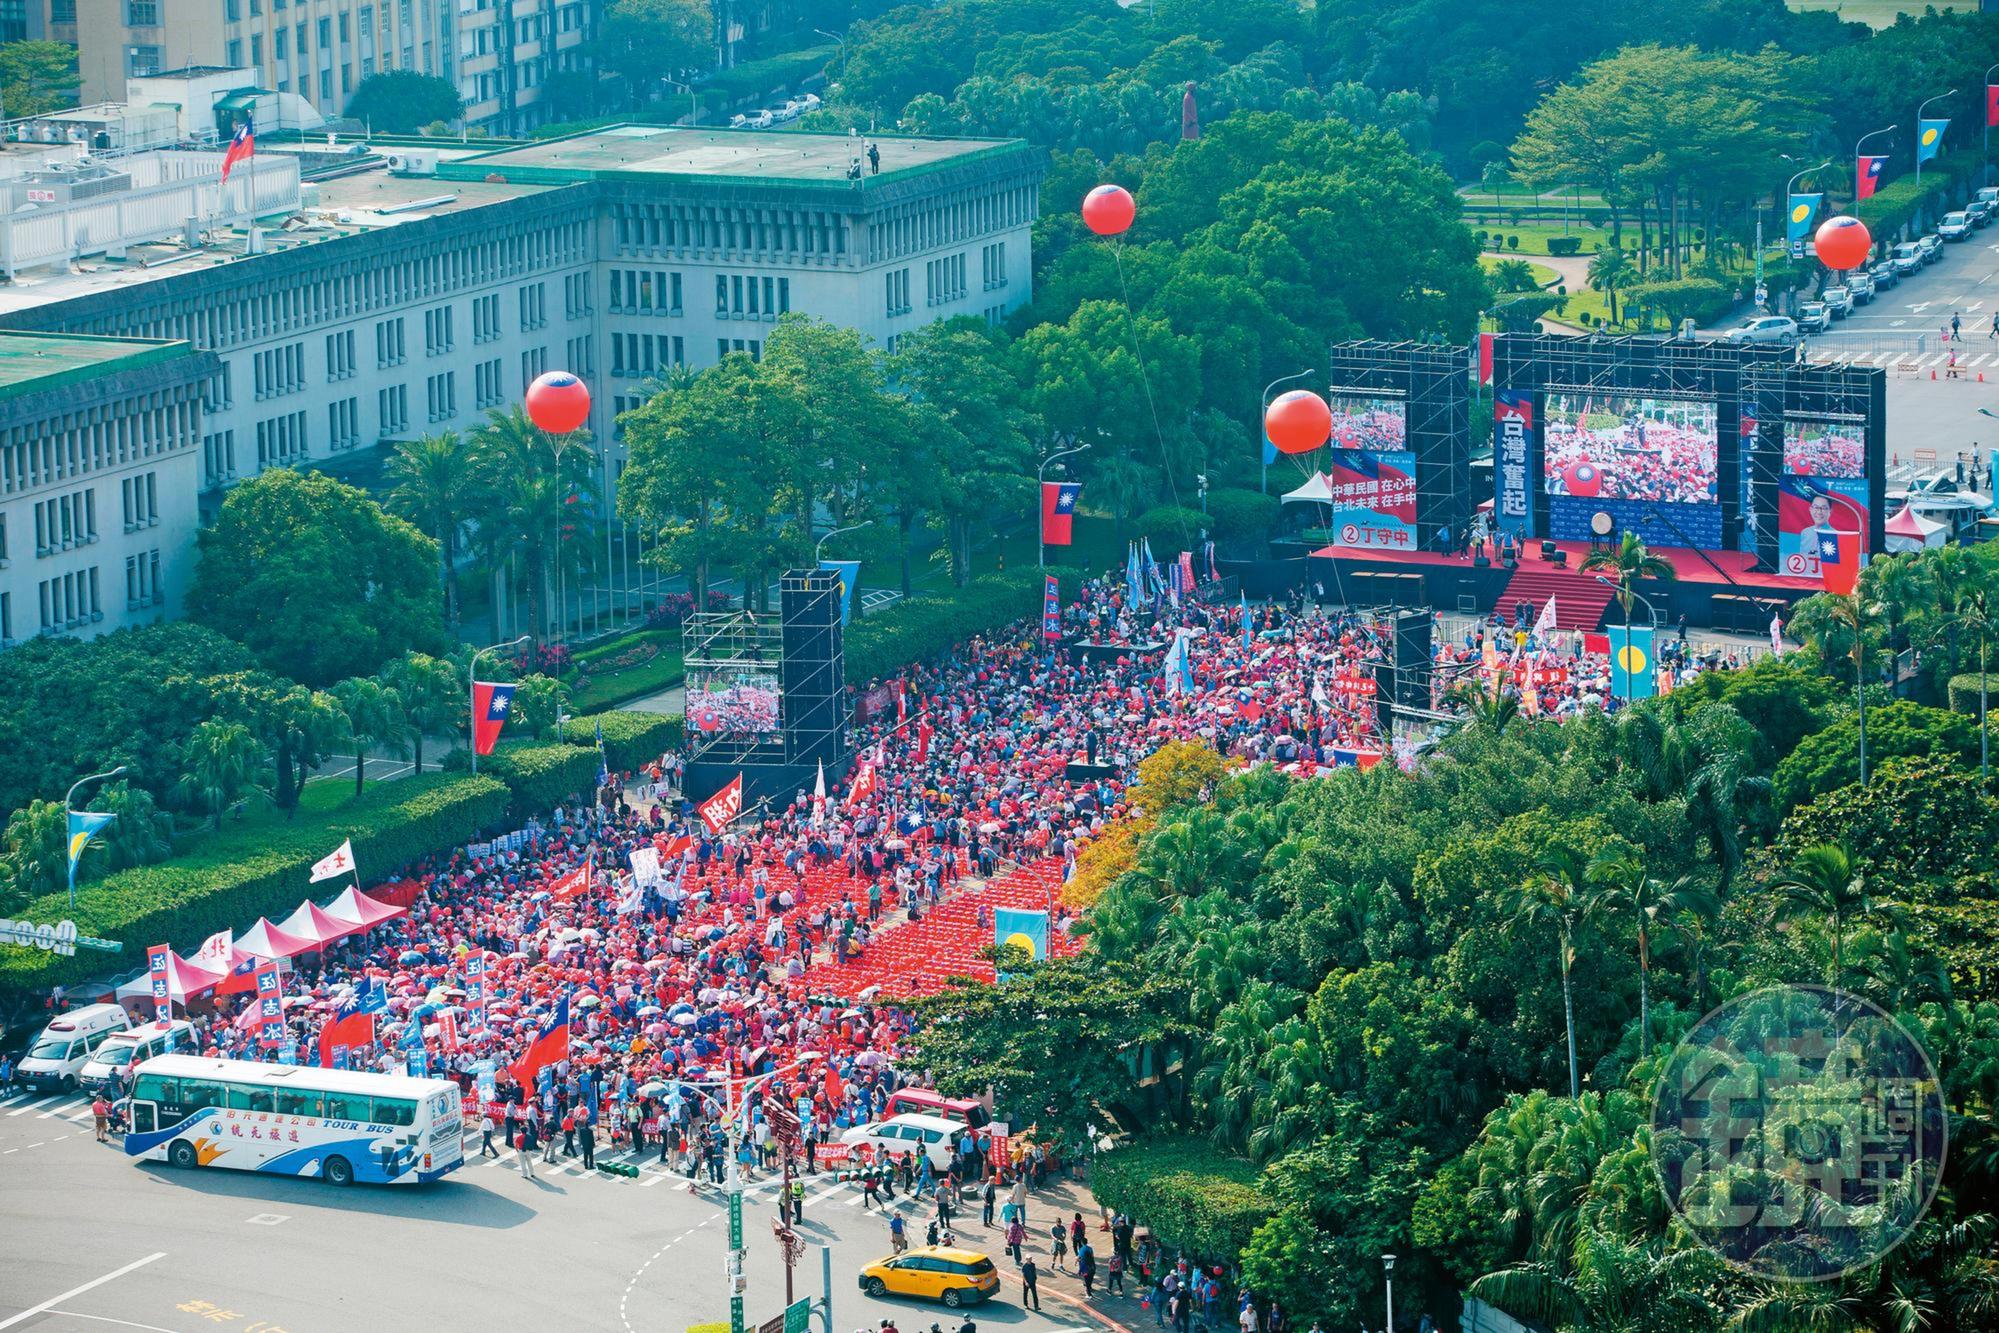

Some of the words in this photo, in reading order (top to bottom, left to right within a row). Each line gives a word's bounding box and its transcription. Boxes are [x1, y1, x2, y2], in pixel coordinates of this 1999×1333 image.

[1502, 410, 1527, 516] 台灣奮起
[1332, 480, 1378, 497] 中華民國
[1381, 477, 1416, 492] 在心中
[1333, 496, 1379, 513] 台北未來
[1381, 492, 1416, 507] 在手中
[322, 1119, 359, 1131] TOUR
[365, 1124, 395, 1134] BUS
